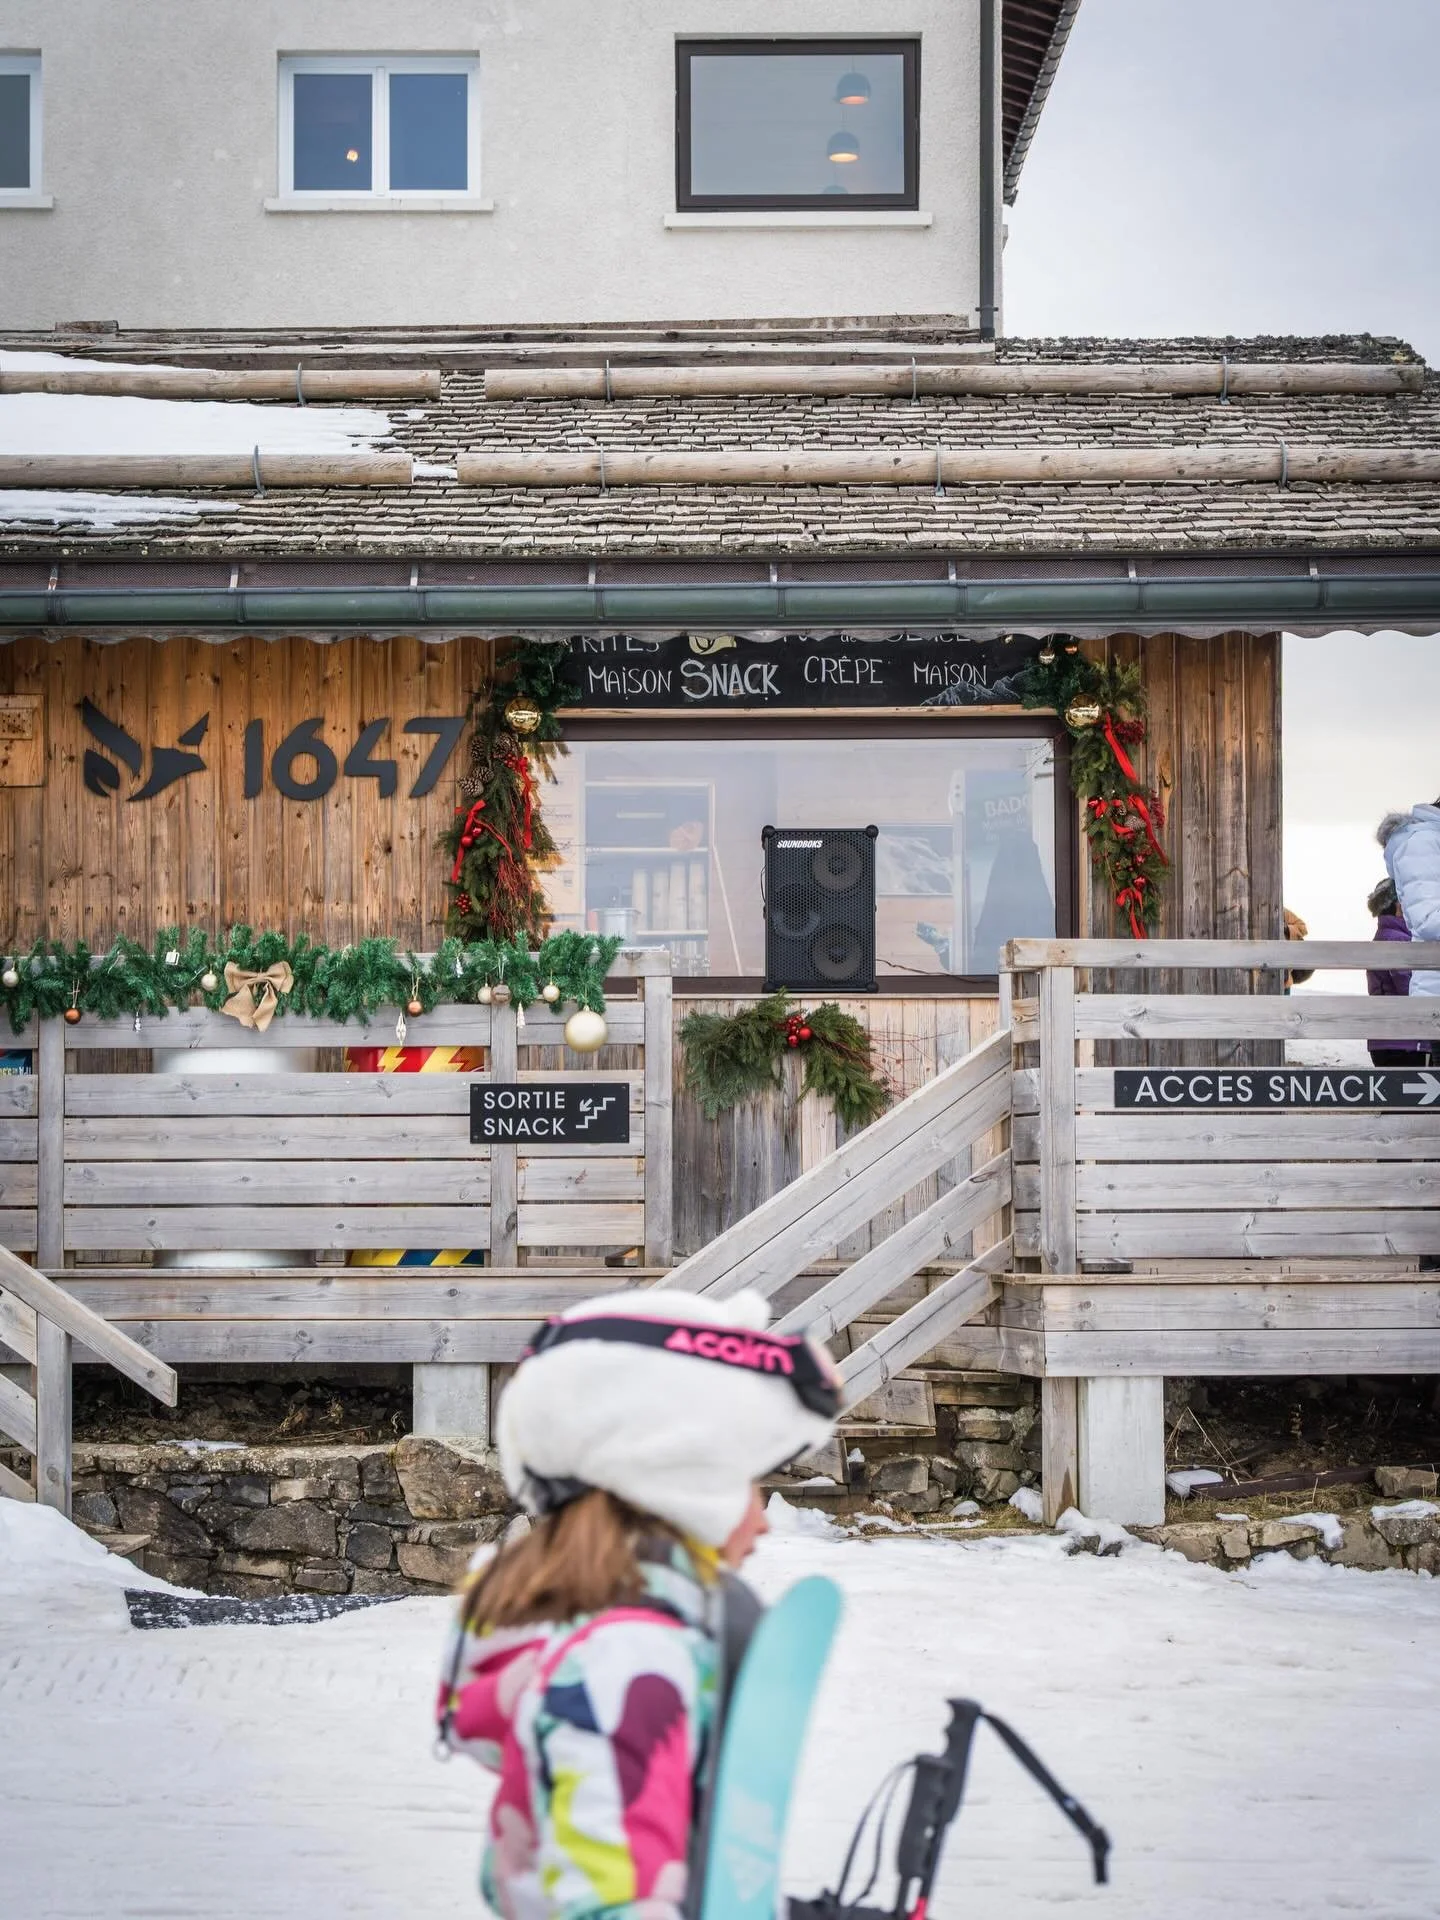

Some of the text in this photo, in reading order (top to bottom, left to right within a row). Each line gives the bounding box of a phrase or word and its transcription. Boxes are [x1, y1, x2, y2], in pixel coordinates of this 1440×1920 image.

[680, 658, 781, 699] SNACK
[804, 656, 884, 685] CRÊPE
[244, 716, 467, 801] 1647
[777, 840, 823, 848] SOUNDBOKS
[483, 1091, 566, 1109] SORTIE
[1134, 1075, 1388, 1102] ACCES SNACK
[483, 1117, 566, 1136] SNACK
